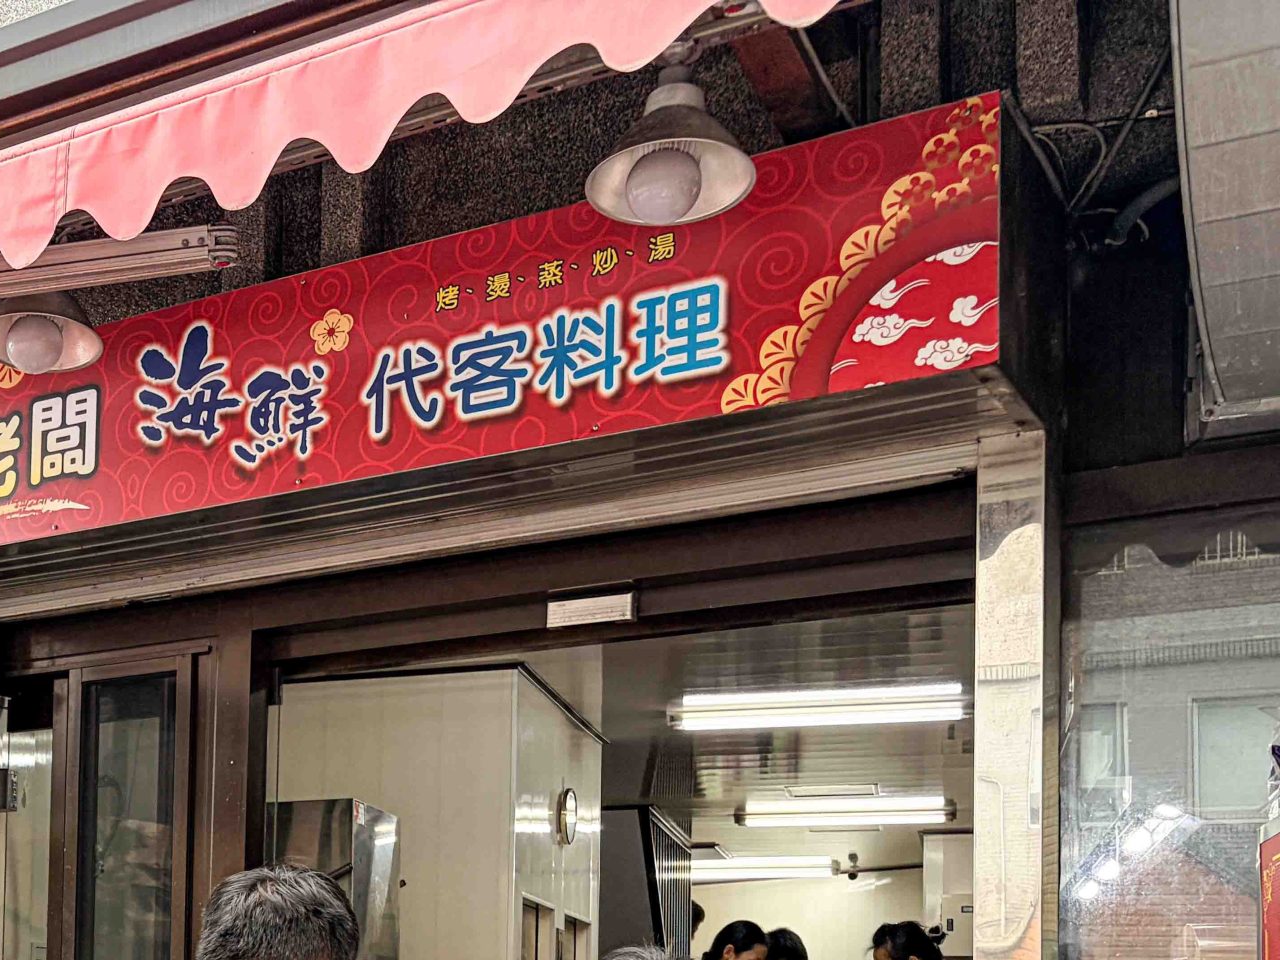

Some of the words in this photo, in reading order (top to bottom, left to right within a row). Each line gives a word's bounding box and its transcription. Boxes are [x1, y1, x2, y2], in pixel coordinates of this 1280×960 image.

[135, 325, 328, 465] 海鮮
[363, 279, 726, 437] 代客料理
